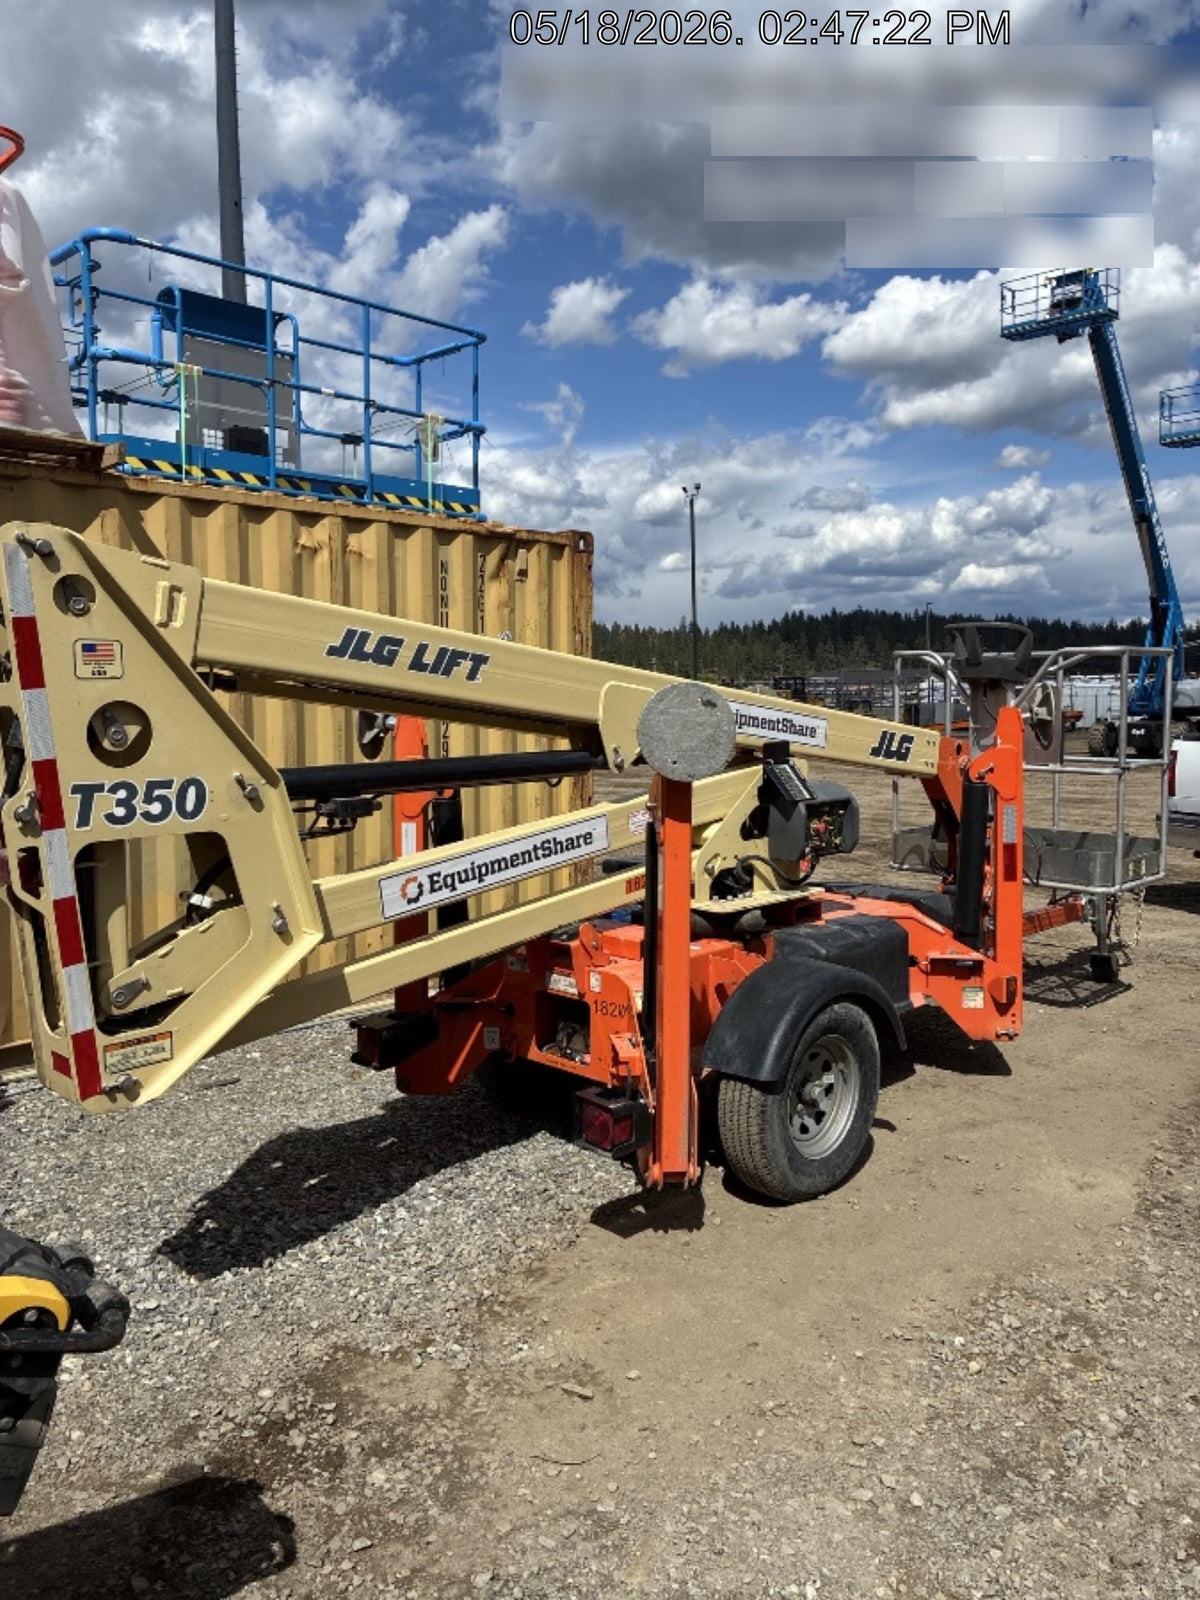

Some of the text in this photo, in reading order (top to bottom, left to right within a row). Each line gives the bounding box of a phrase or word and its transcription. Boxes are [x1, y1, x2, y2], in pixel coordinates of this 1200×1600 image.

[325, 627, 491, 682] JLG LIFT
[869, 728, 917, 763] JLG
[69, 776, 208, 831] T350
[428, 831, 593, 892] EquipmentShare
